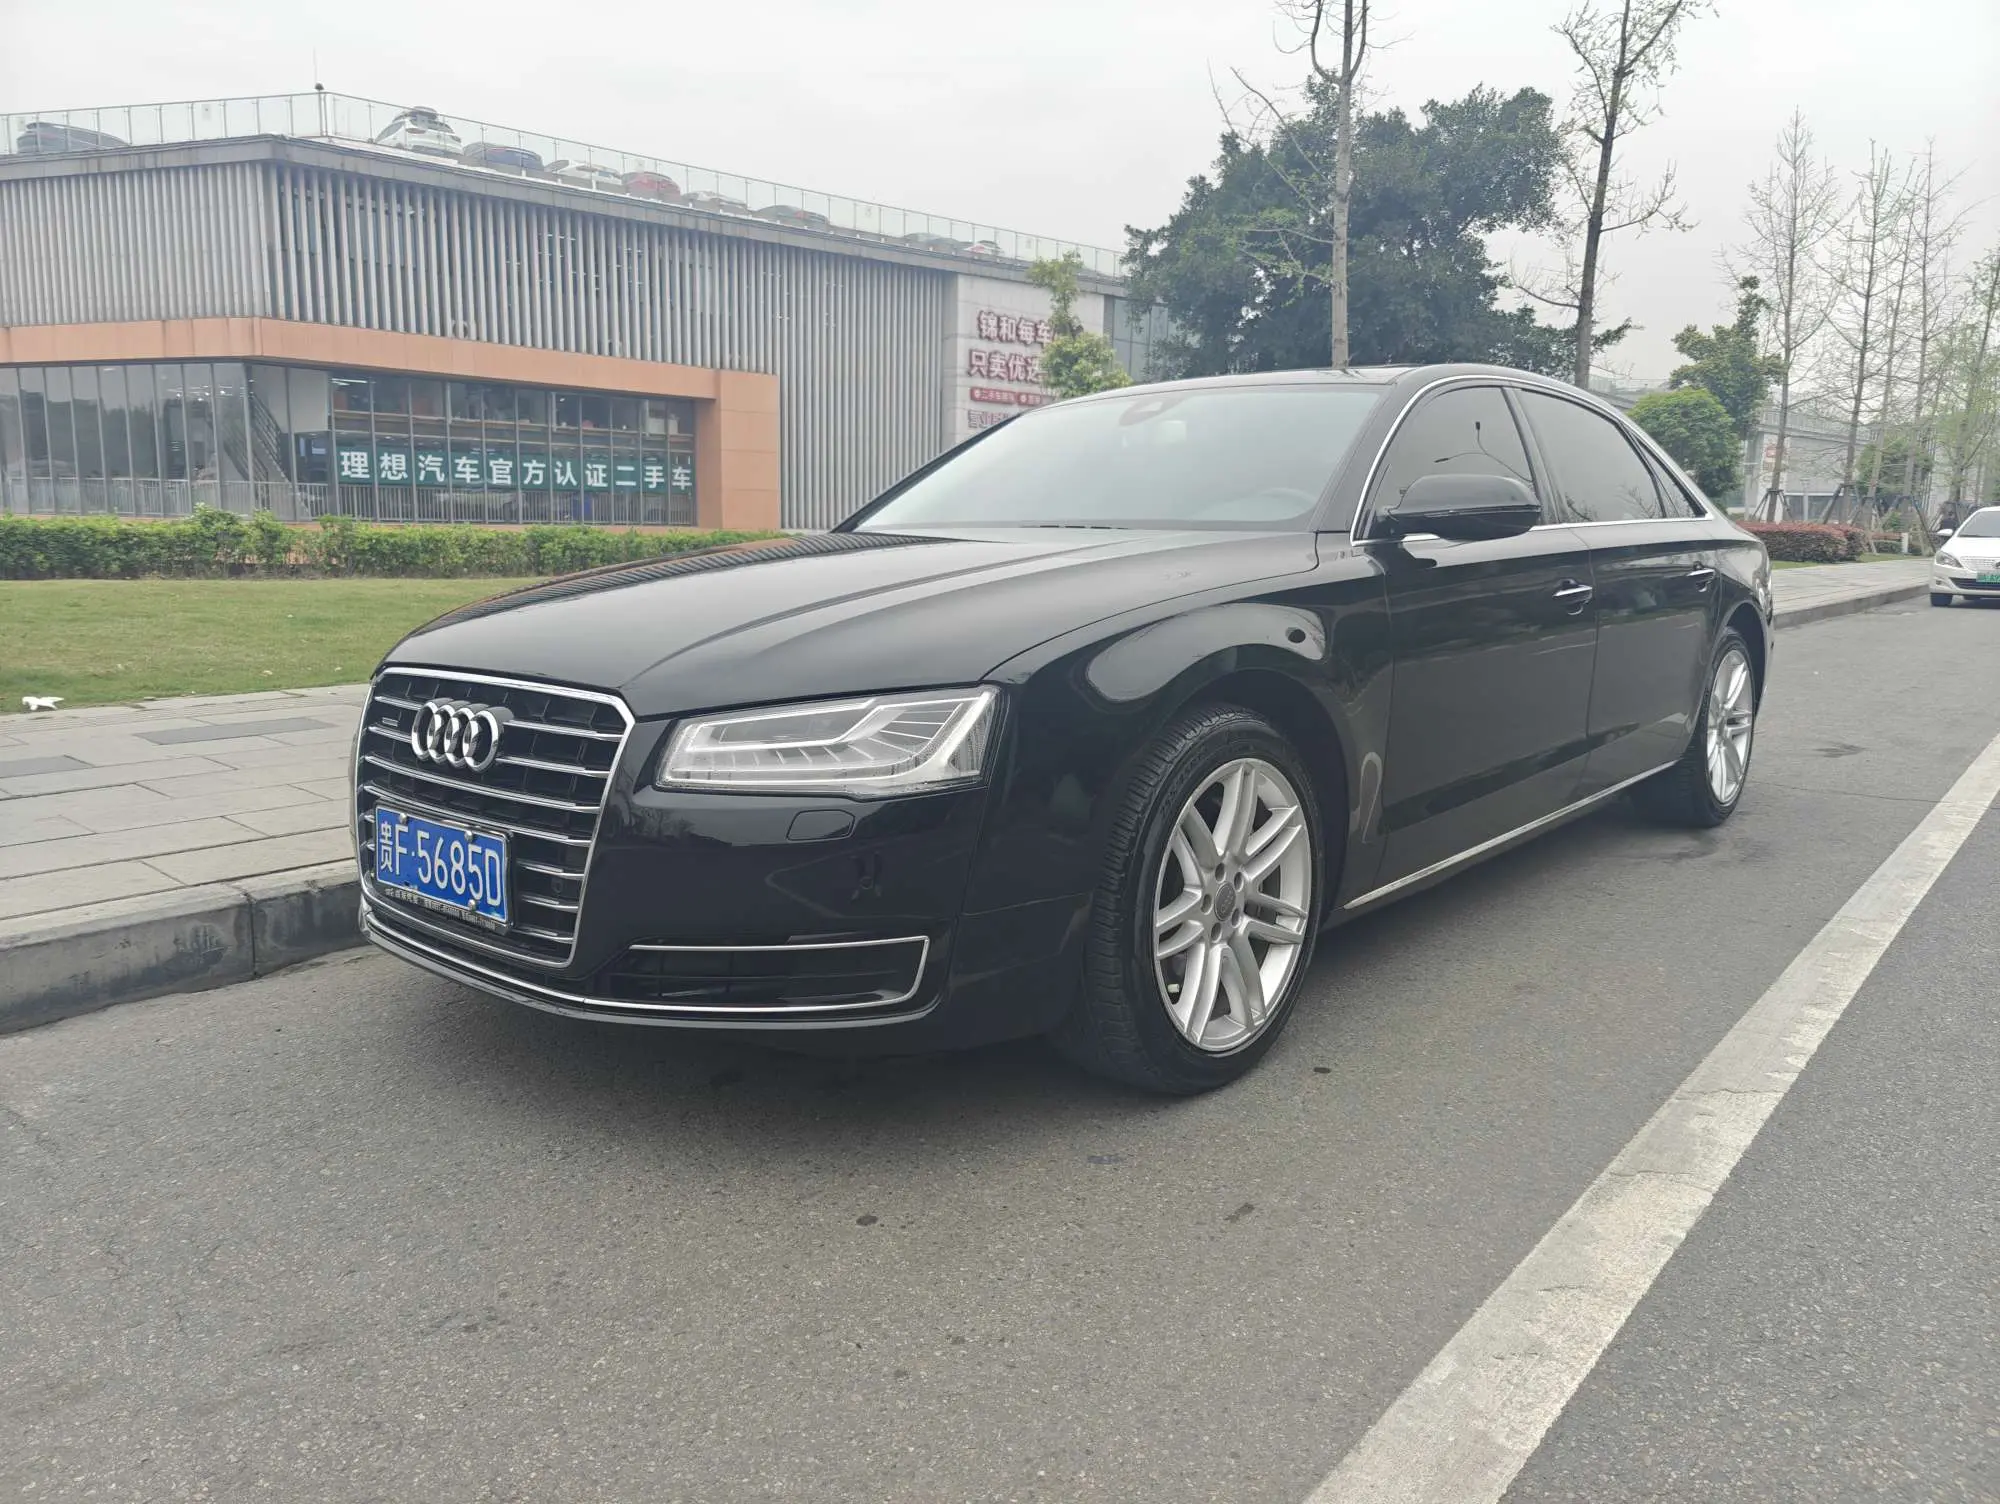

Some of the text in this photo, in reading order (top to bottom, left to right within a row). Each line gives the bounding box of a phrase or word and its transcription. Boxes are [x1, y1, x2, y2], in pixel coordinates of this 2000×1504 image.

[339, 451, 693, 490] 理想汽车官方认证二手车
